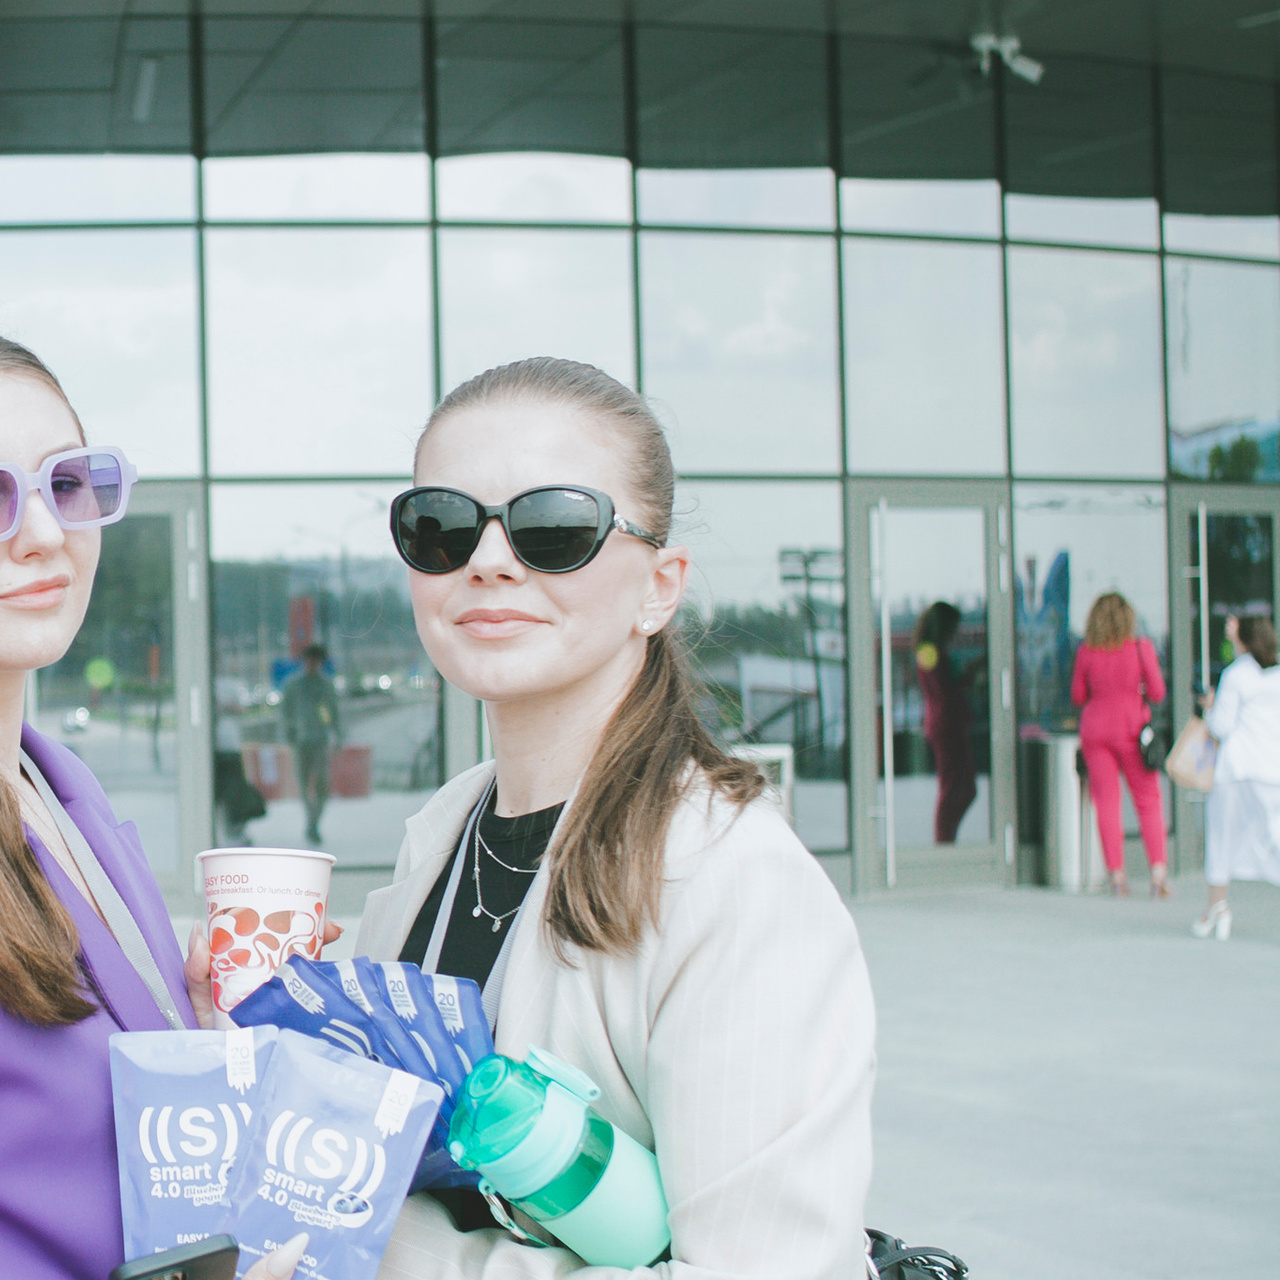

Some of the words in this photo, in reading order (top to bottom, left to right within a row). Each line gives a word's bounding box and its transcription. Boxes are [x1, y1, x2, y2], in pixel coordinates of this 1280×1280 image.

[220, 874, 249, 885] FOOD
[257, 886, 267, 894] Or
[295, 888, 304, 896] Or
[288, 978, 302, 994] 20
[344, 979, 358, 992] 20
[389, 980, 405, 992] 20
[438, 992, 455, 1006] 20
[230, 1046, 250, 1059] 20
[150, 1162, 212, 1181] smart
[151, 1181, 180, 1198] 4.0
[263, 1168, 325, 1202] smart
[257, 1184, 288, 1206] 4.0
